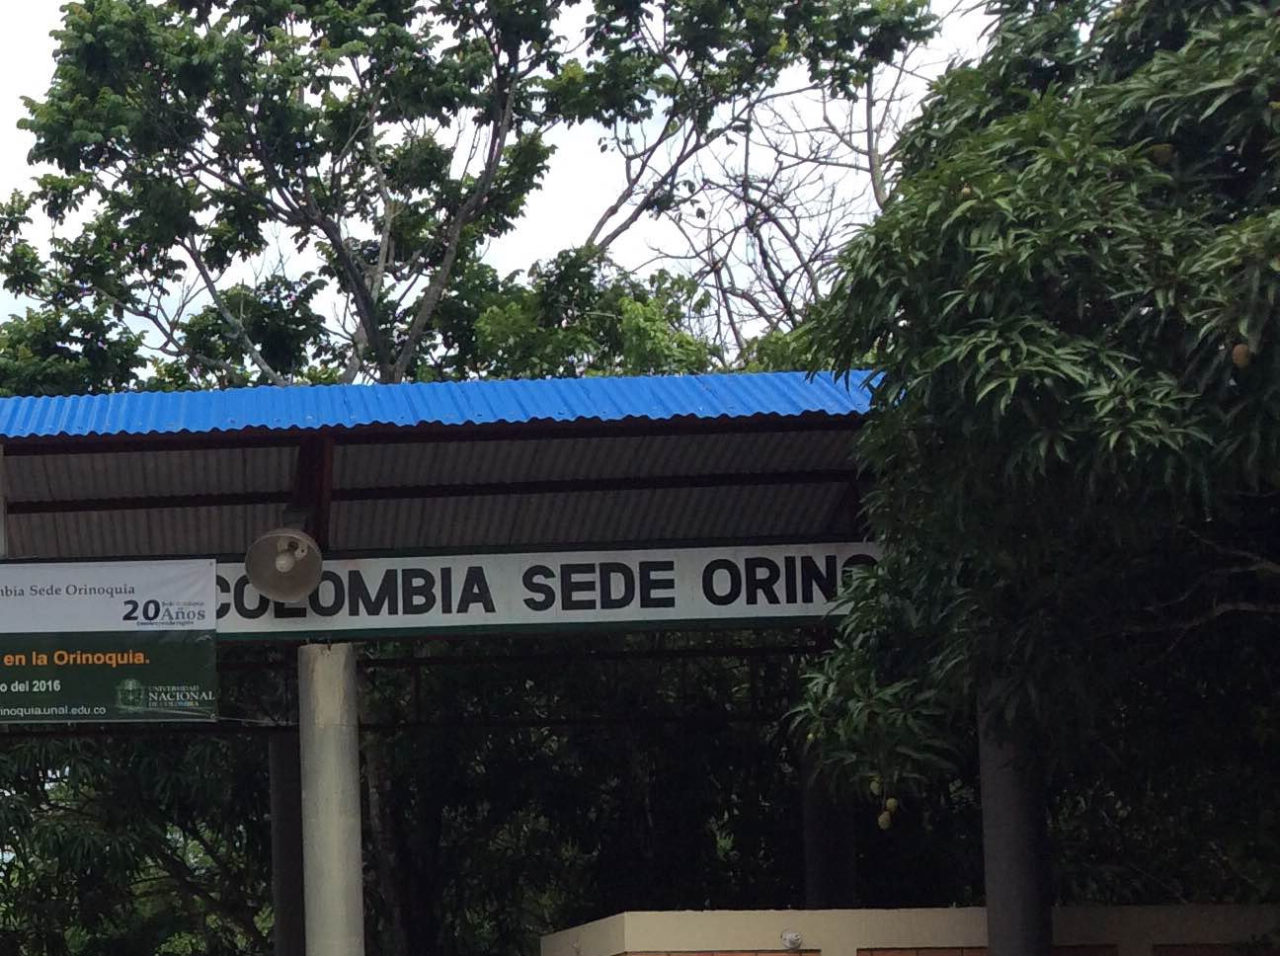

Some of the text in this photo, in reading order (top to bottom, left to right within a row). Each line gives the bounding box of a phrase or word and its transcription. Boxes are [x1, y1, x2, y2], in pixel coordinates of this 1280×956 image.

[29, 584, 62, 597] Sede
[522, 559, 675, 611] SEDE
[122, 599, 206, 621] 20 Años
[4, 653, 26, 666] en
[32, 651, 48, 665] la
[11, 681, 29, 693] del
[32, 680, 61, 692] 2016
[148, 691, 216, 701] NACIONAL
